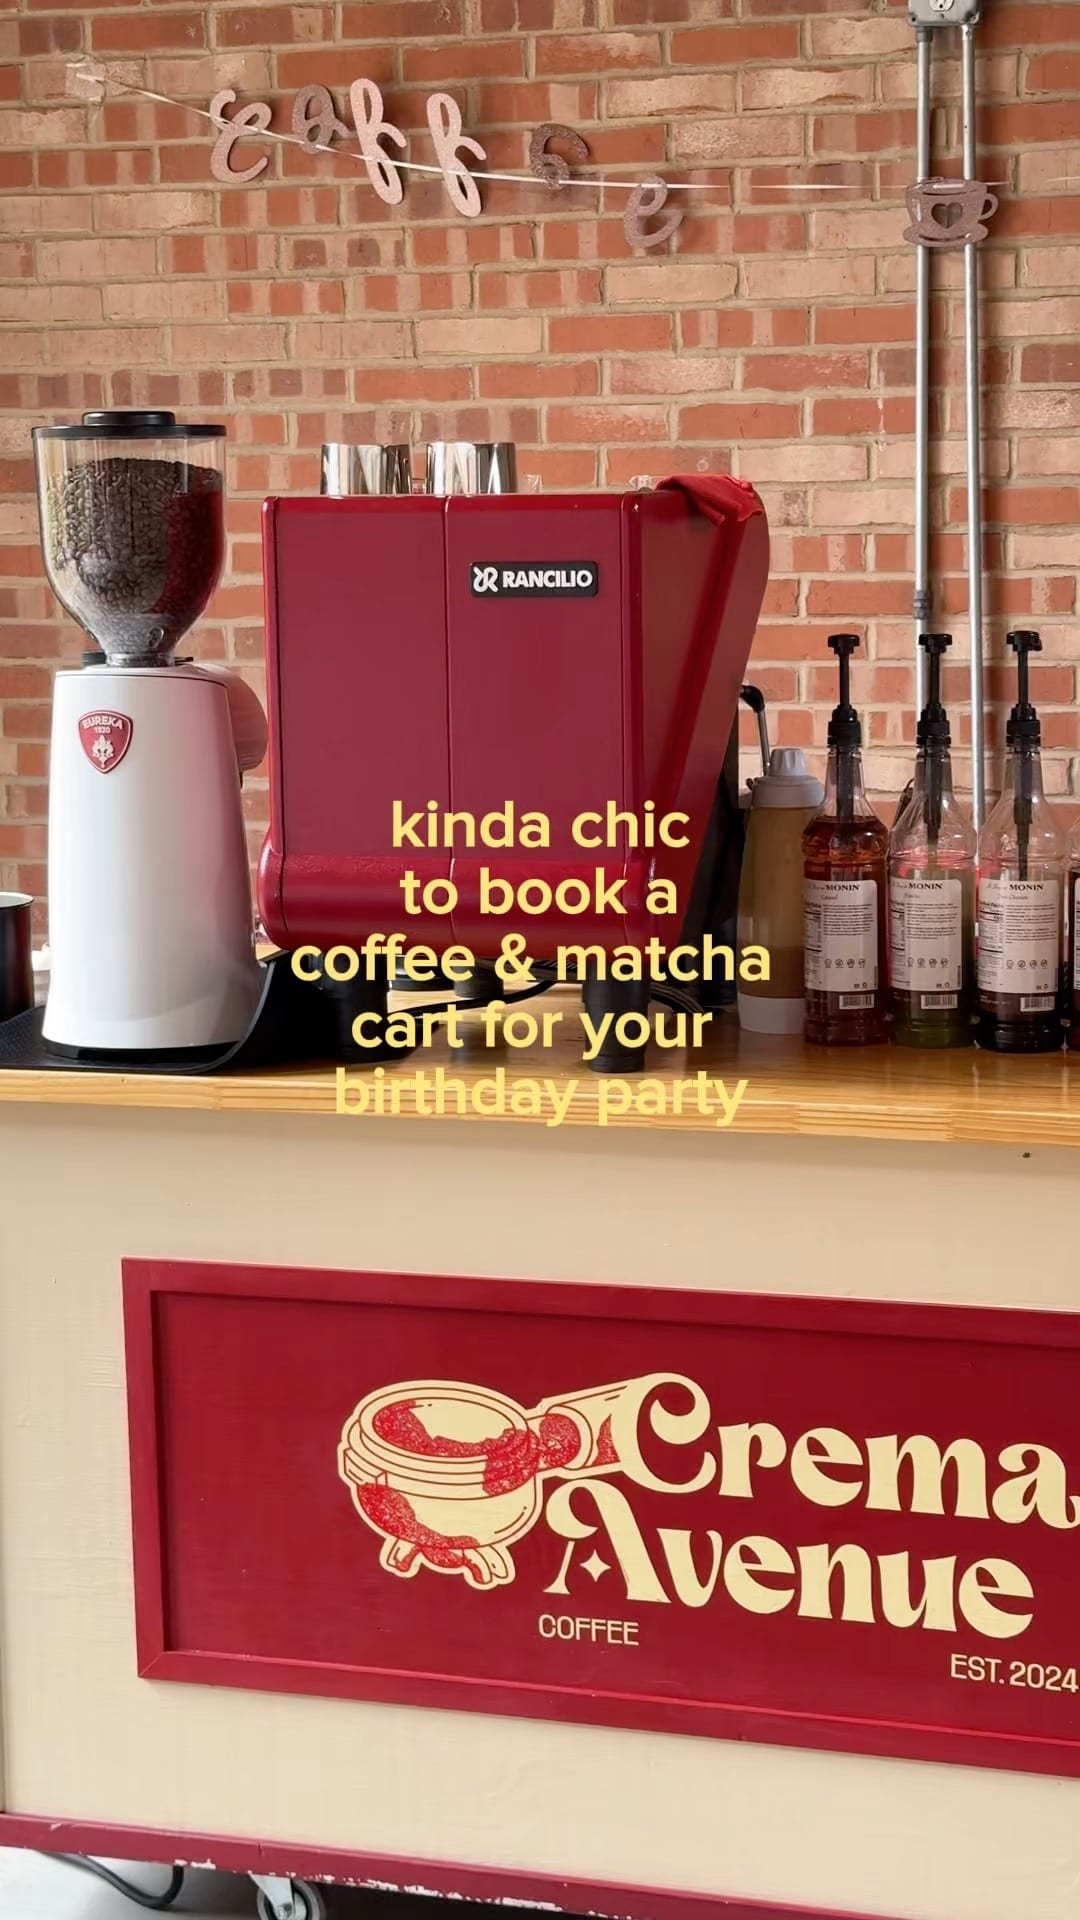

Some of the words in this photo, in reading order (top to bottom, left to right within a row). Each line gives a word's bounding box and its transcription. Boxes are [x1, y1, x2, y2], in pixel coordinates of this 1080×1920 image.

[502, 569, 593, 588] RANCILIO
[81, 715, 123, 730] EUREKA
[825, 883, 860, 892] MONIN
[908, 882, 943, 890] MONIN
[1008, 883, 1044, 892] MONIN
[608, 1372, 1080, 1530] Crema
[543, 1477, 1034, 1640] Avenue
[538, 1613, 640, 1647] COFFEE
